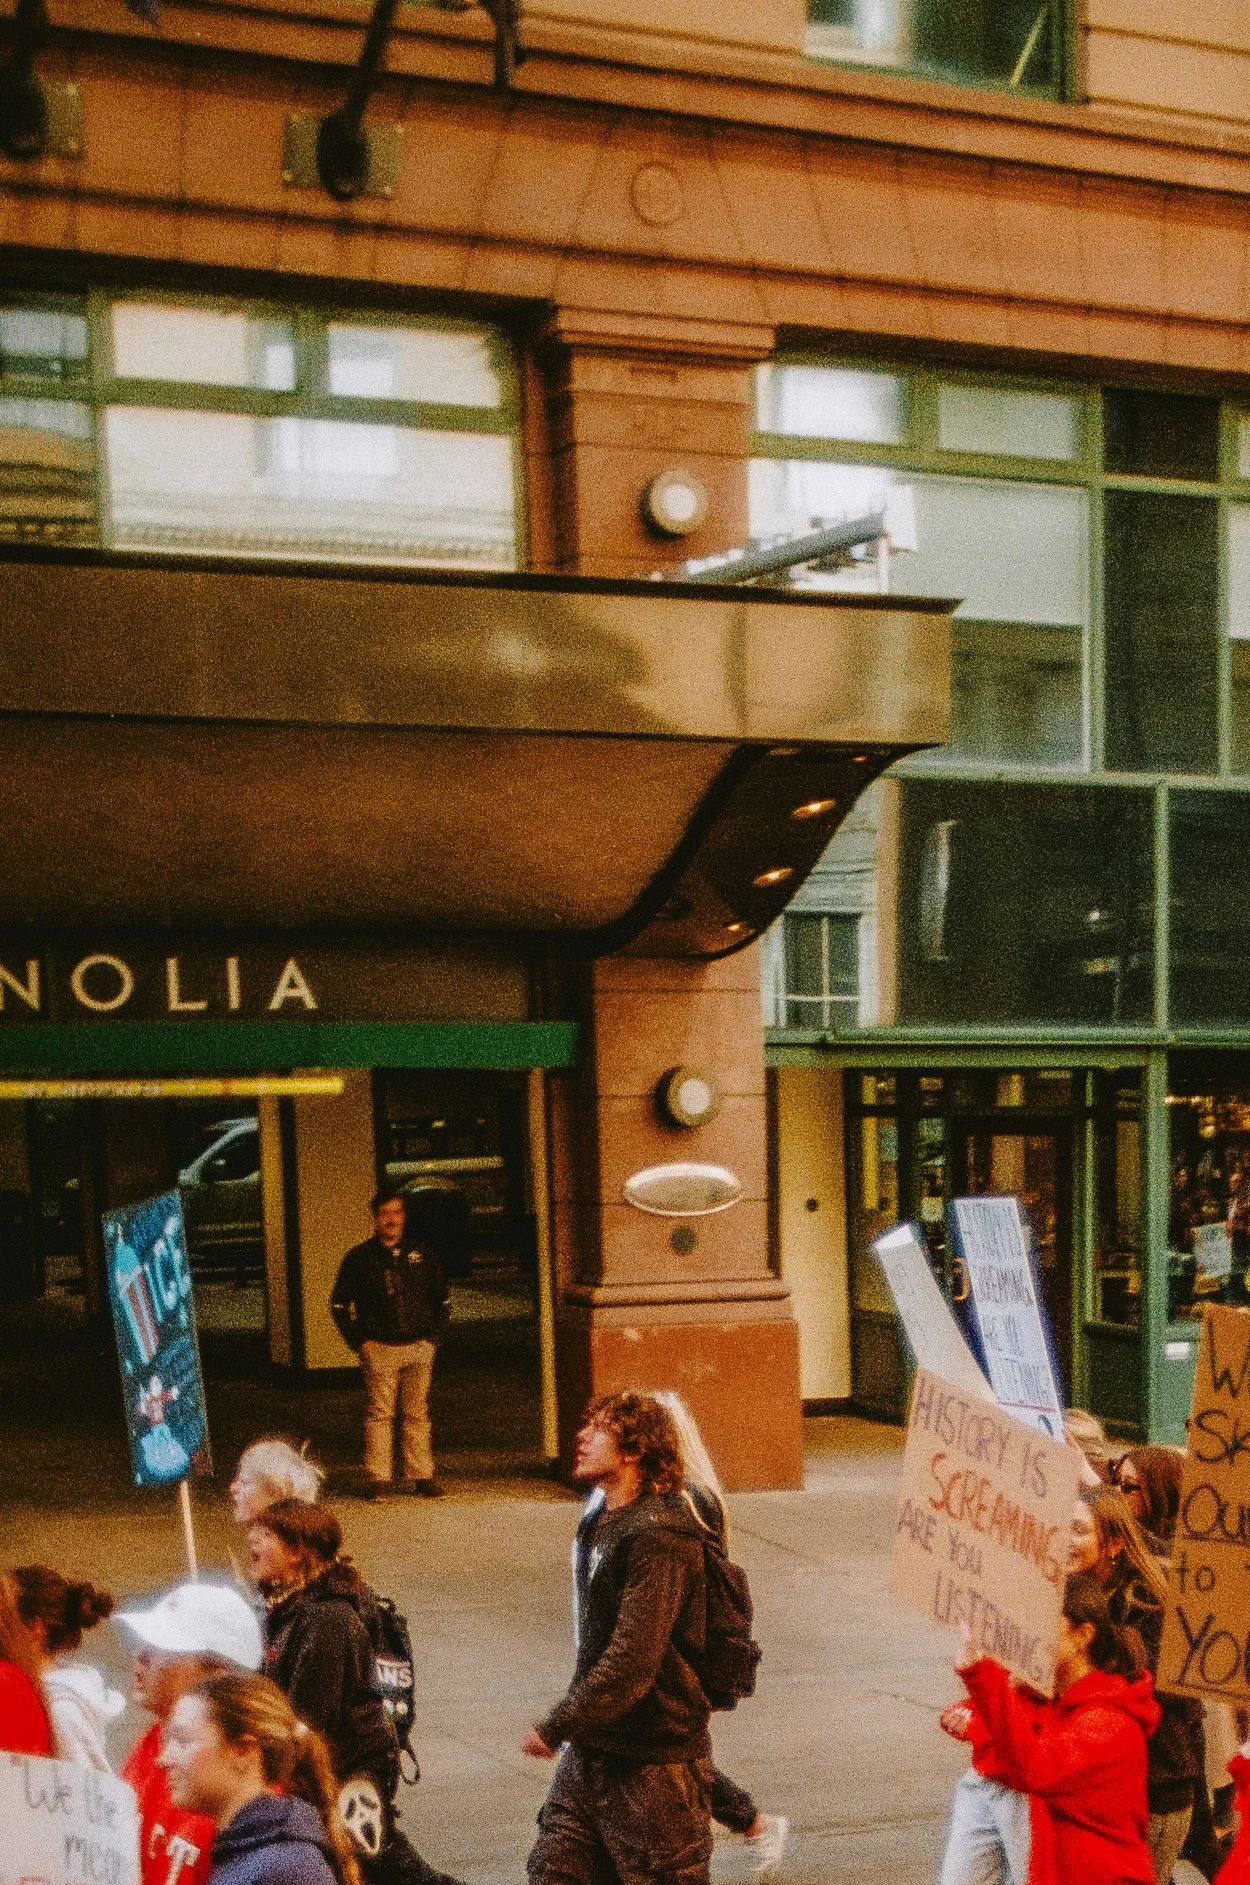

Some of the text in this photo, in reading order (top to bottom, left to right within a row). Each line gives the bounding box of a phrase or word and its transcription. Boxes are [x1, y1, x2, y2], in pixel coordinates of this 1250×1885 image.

[0, 953, 319, 1013] NOLIA
[912, 1376, 1049, 1499] HISTORY IS
[897, 1498, 983, 1578] ARE YOU
[928, 1451, 1060, 1583] SCREAMING
[1174, 1552, 1217, 1593] to
